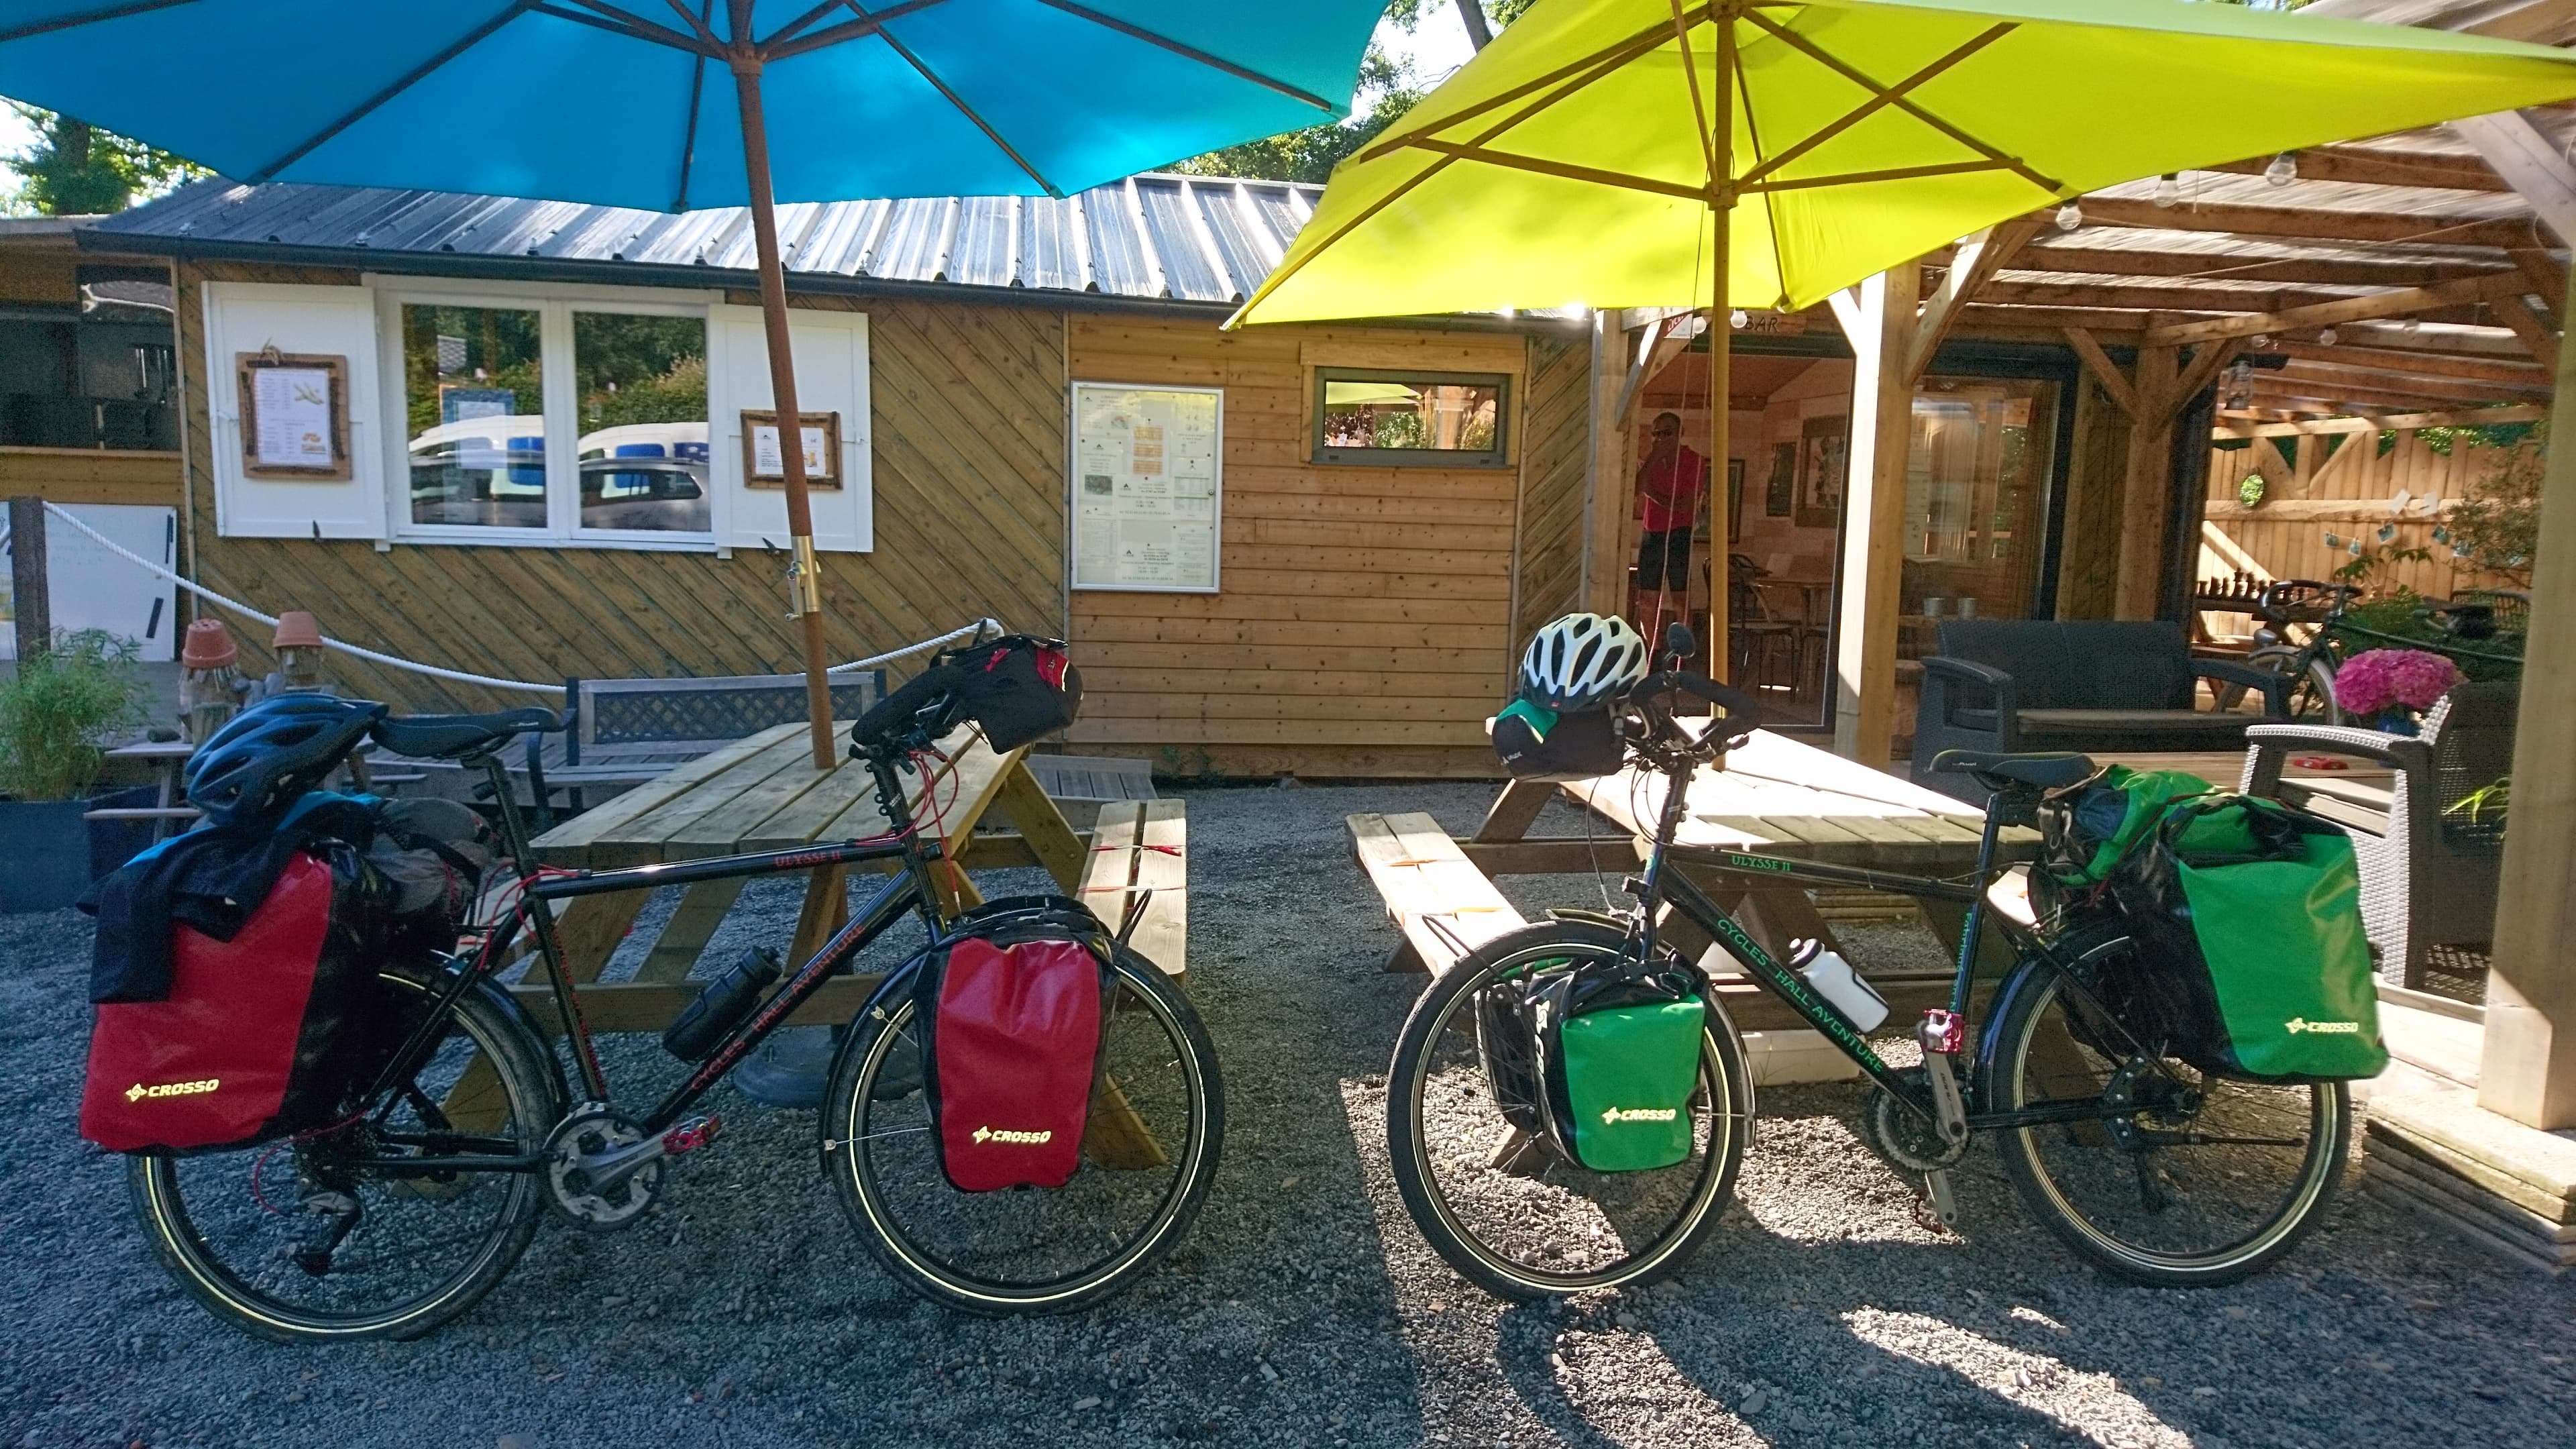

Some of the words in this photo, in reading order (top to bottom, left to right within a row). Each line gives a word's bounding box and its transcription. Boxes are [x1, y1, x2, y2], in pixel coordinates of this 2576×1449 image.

[1746, 315, 1779, 333] BAR
[773, 852, 826, 867] ULYSSE
[1731, 855, 1778, 869] ULYSSE
[1782, 861, 1790, 871] II
[1717, 918, 1768, 966] CYCLES
[1775, 969, 1809, 1006] HALL
[1812, 1005, 1884, 1073] AVENTURE
[691, 1040, 745, 1090] CYCLES
[752, 999, 790, 1032] HALL
[792, 924, 865, 996] AVENTURE
[2307, 1022, 2359, 1032] CROSSO
[148, 1079, 219, 1097] CROSSO
[1620, 1109, 1676, 1121] CROSSO
[991, 1130, 1052, 1143] CROSSO
